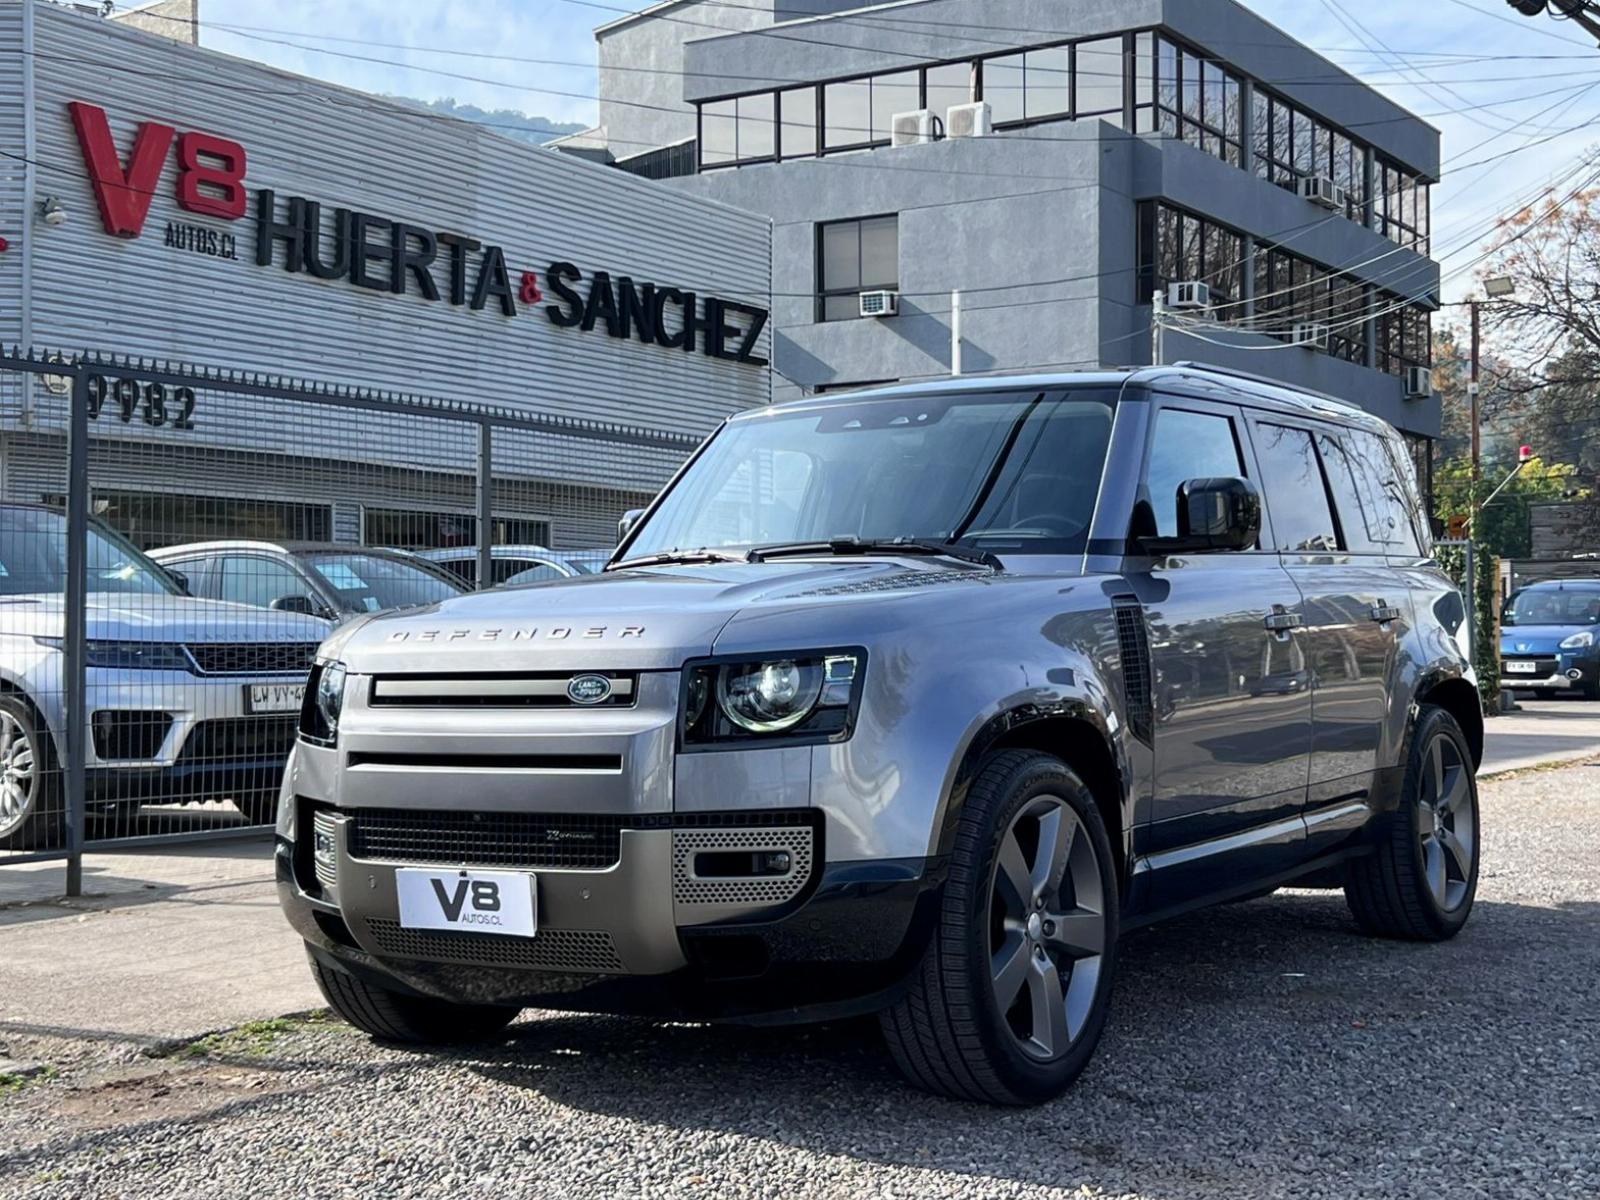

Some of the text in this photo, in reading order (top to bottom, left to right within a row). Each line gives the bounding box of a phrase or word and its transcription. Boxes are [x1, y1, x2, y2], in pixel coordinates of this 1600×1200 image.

[68, 101, 247, 239] V8
[164, 221, 239, 261] AUTOS.CL
[256, 188, 770, 366] HUERTA & SANCHEZ
[87, 373, 195, 430] 9982
[386, 626, 646, 642] DEFENDER
[430, 878, 501, 922] V8
[461, 913, 503, 926] AUTOS.CL
